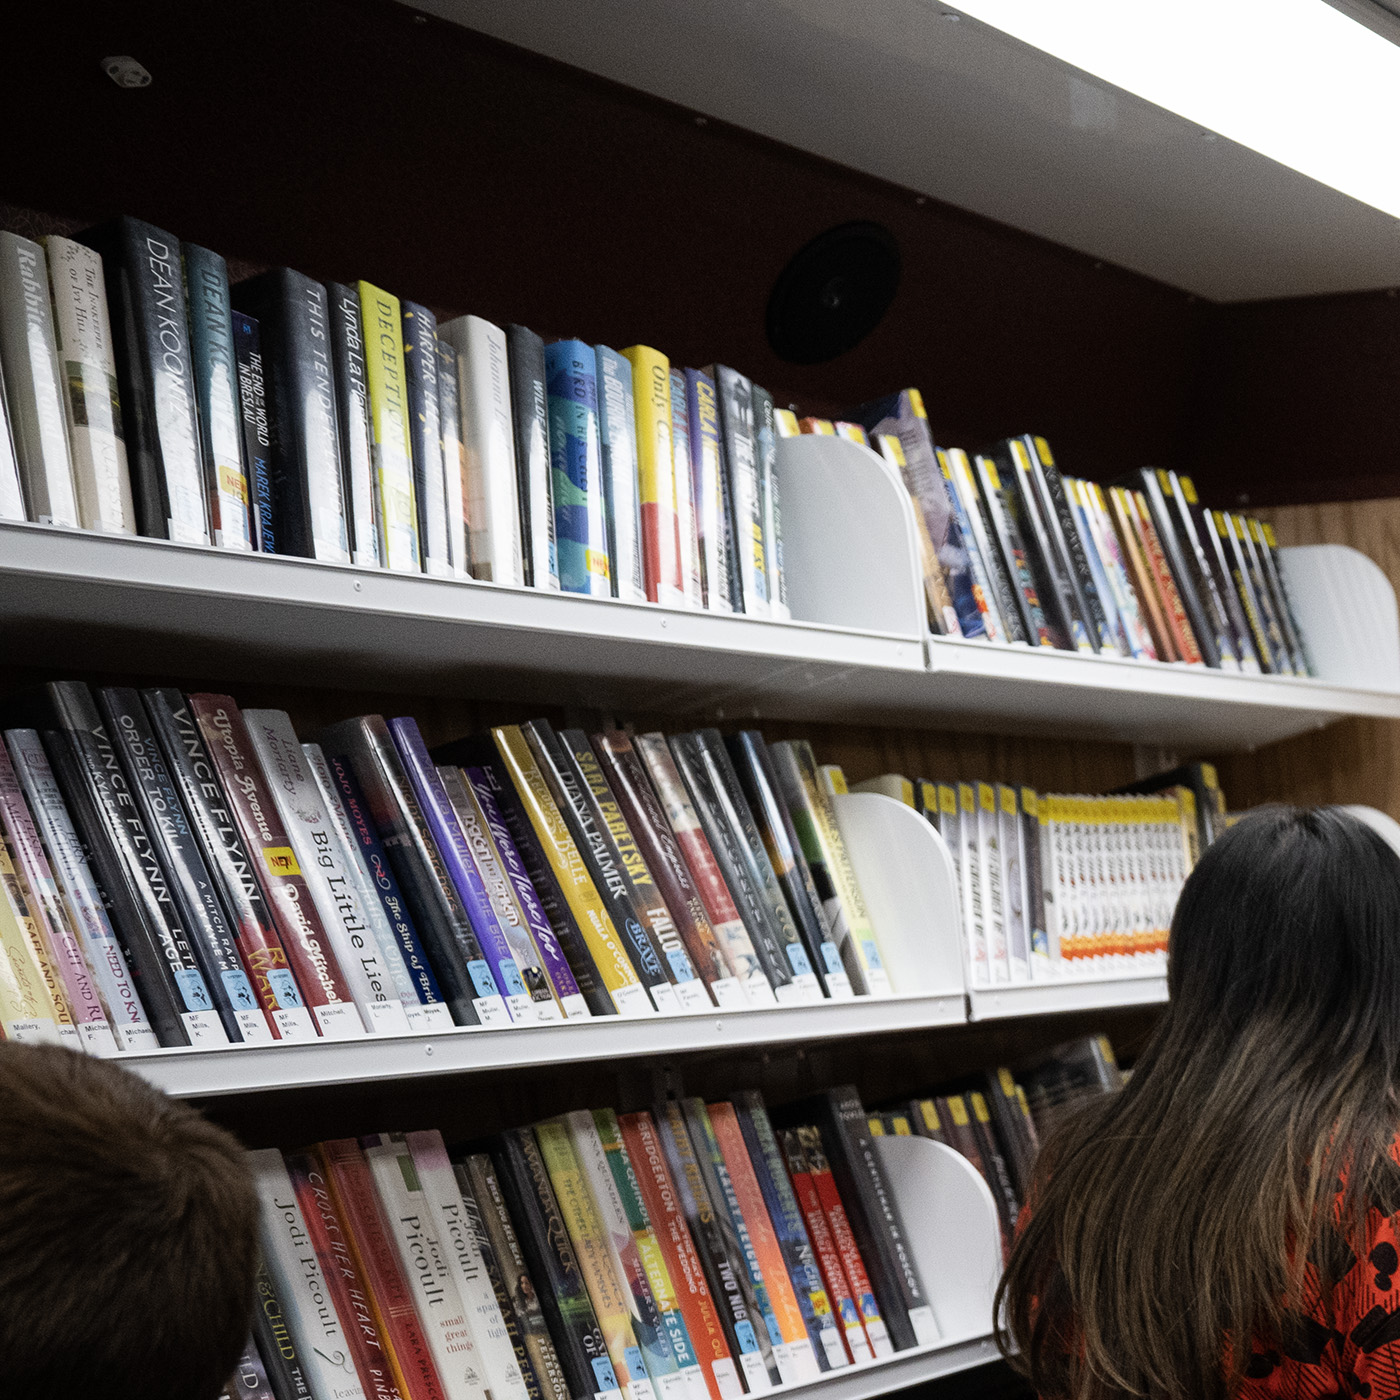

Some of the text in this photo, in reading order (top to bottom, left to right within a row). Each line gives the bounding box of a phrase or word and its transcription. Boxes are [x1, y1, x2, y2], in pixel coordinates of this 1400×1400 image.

[146, 237, 189, 416] DEAN KOONTZ
[200, 268, 227, 338] DEAN
[339, 297, 364, 378] Lynda La
[306, 289, 335, 437] THIS TENDER
[416, 311, 436, 385] HARPER
[239, 363, 256, 424] IN BRESLAU
[249, 352, 270, 447] THE END WORLD
[254, 456, 270, 498] MAREK
[119, 714, 184, 852] ORDER TO KILL
[143, 738, 188, 836] VINCE FLYNN
[213, 708, 273, 842] Utopia Avenue
[262, 725, 297, 796] Moriarty
[281, 738, 305, 783] Liane
[92, 726, 170, 902] VINCE FLYNN
[172, 707, 260, 901] VINCE FLYNN
[332, 757, 372, 847] JOJO MOYES
[560, 771, 629, 901] DIANA PALMER
[575, 750, 653, 887] SARA PARETSKY
[446, 819, 479, 880] Muller
[475, 890, 494, 918] THE
[473, 782, 560, 962] You Were There Too
[203, 894, 226, 935] MITCH
[221, 938, 240, 971] RAPP
[284, 883, 315, 941] David
[310, 830, 388, 1003] Big Little Lies
[385, 896, 425, 971] The Ship of
[586, 908, 609, 942] NUALA
[25, 922, 56, 990] SAFE AND
[62, 937, 94, 1001] CUT AND
[103, 945, 131, 999] NEED TO
[631, 922, 661, 977] BRAVE
[610, 1121, 631, 1166] ANNA
[636, 1121, 677, 1213] BRIDGERTON
[274, 1197, 337, 1338] Jodi Picoult
[308, 1171, 340, 1235] CROSS
[331, 1241, 356, 1280] HER
[348, 1287, 381, 1351] HEART
[400, 1214, 445, 1308] Picoult
[426, 1236, 450, 1278] Jodi
[441, 1203, 480, 1284] Picoult
[667, 1221, 698, 1294] THE WEDDING
[675, 1215, 708, 1296] ON THE WAY TO
[717, 1261, 738, 1293] TWO
[895, 1243, 921, 1299] MOSCOW
[263, 1299, 296, 1361] CHILD
[439, 1315, 465, 1329] small
[444, 1328, 468, 1343] great
[489, 1316, 499, 1325] of
[640, 1243, 691, 1364] ALTERNATE SIDE
[697, 1300, 716, 1336] JULIA
[291, 1366, 308, 1394] THE
[445, 1341, 474, 1354] things
